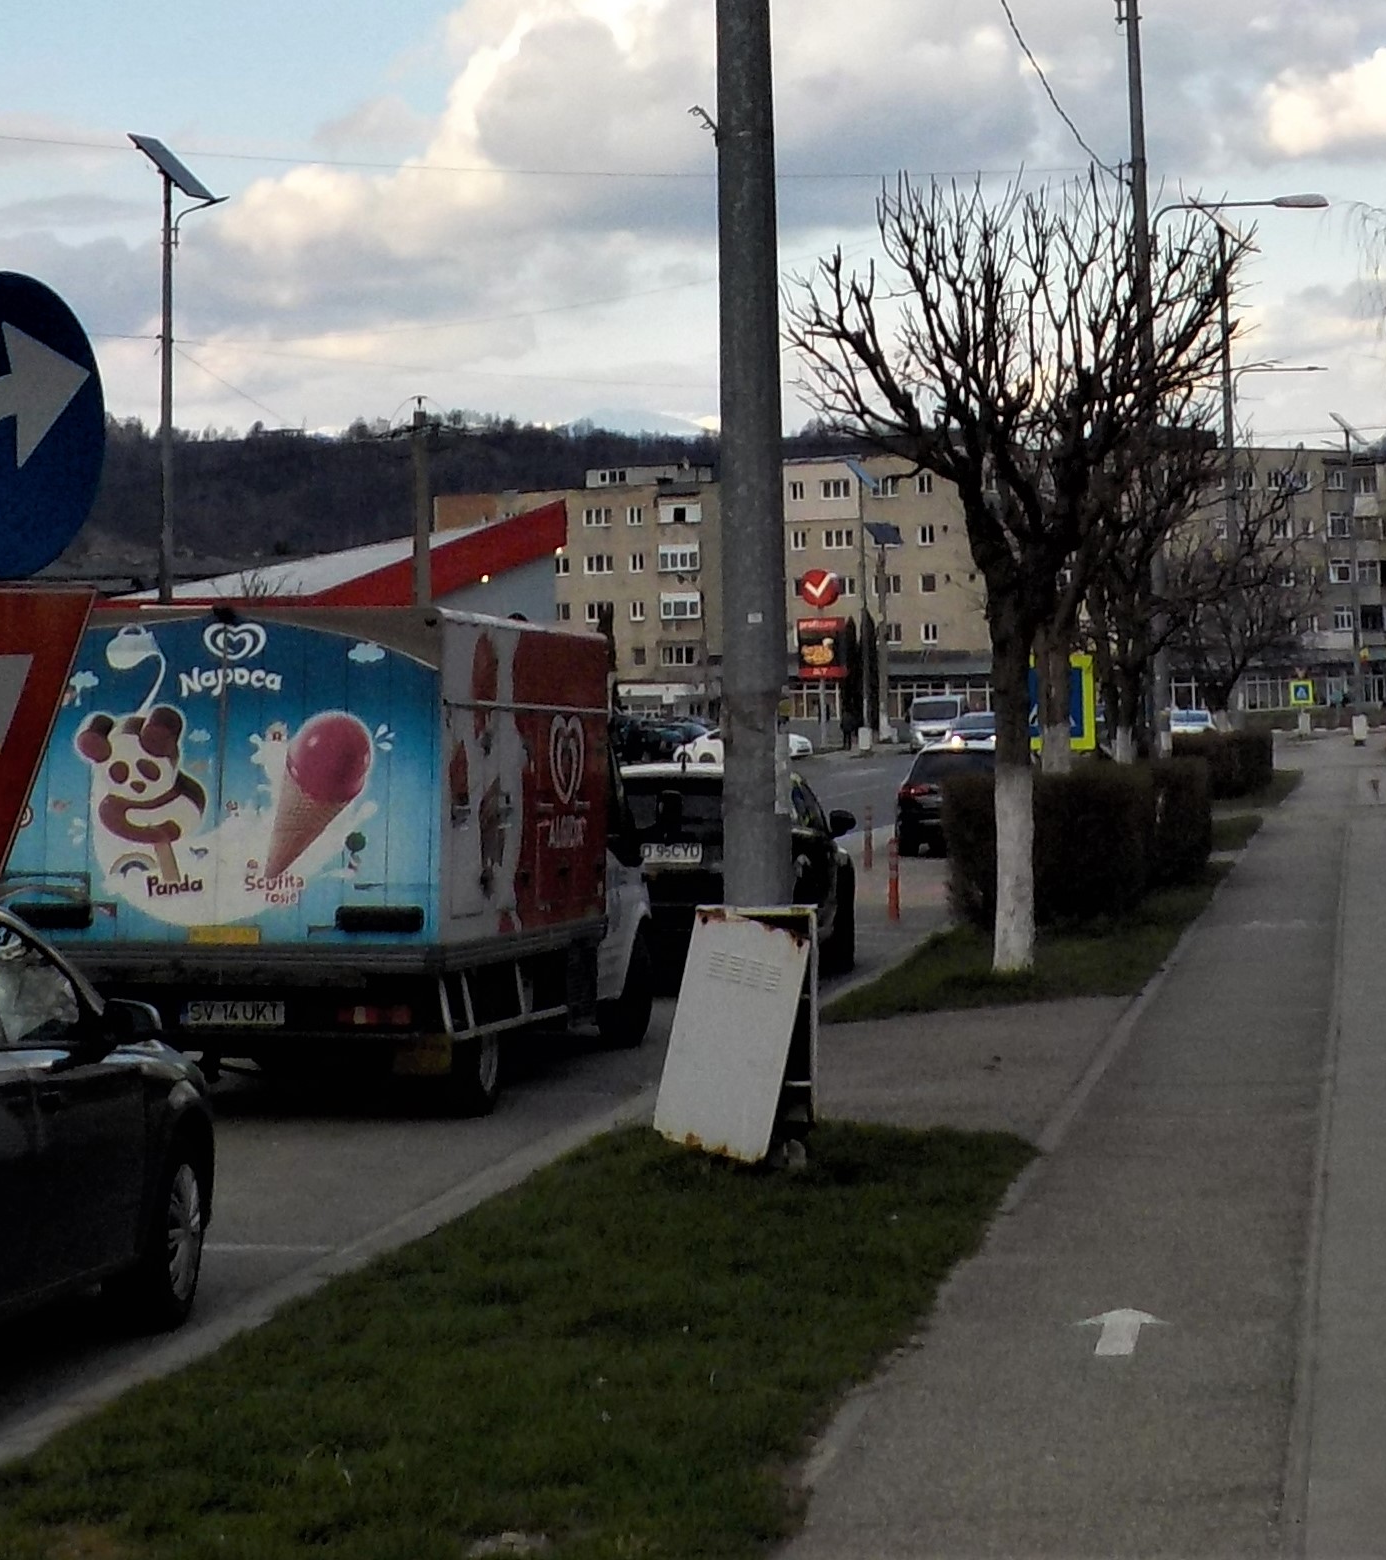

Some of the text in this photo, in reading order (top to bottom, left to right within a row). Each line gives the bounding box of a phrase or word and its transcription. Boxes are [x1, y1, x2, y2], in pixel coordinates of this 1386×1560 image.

[178, 666, 283, 698] Napoca
[146, 874, 203, 897] Panda
[190, 1002, 215, 1021] SV
